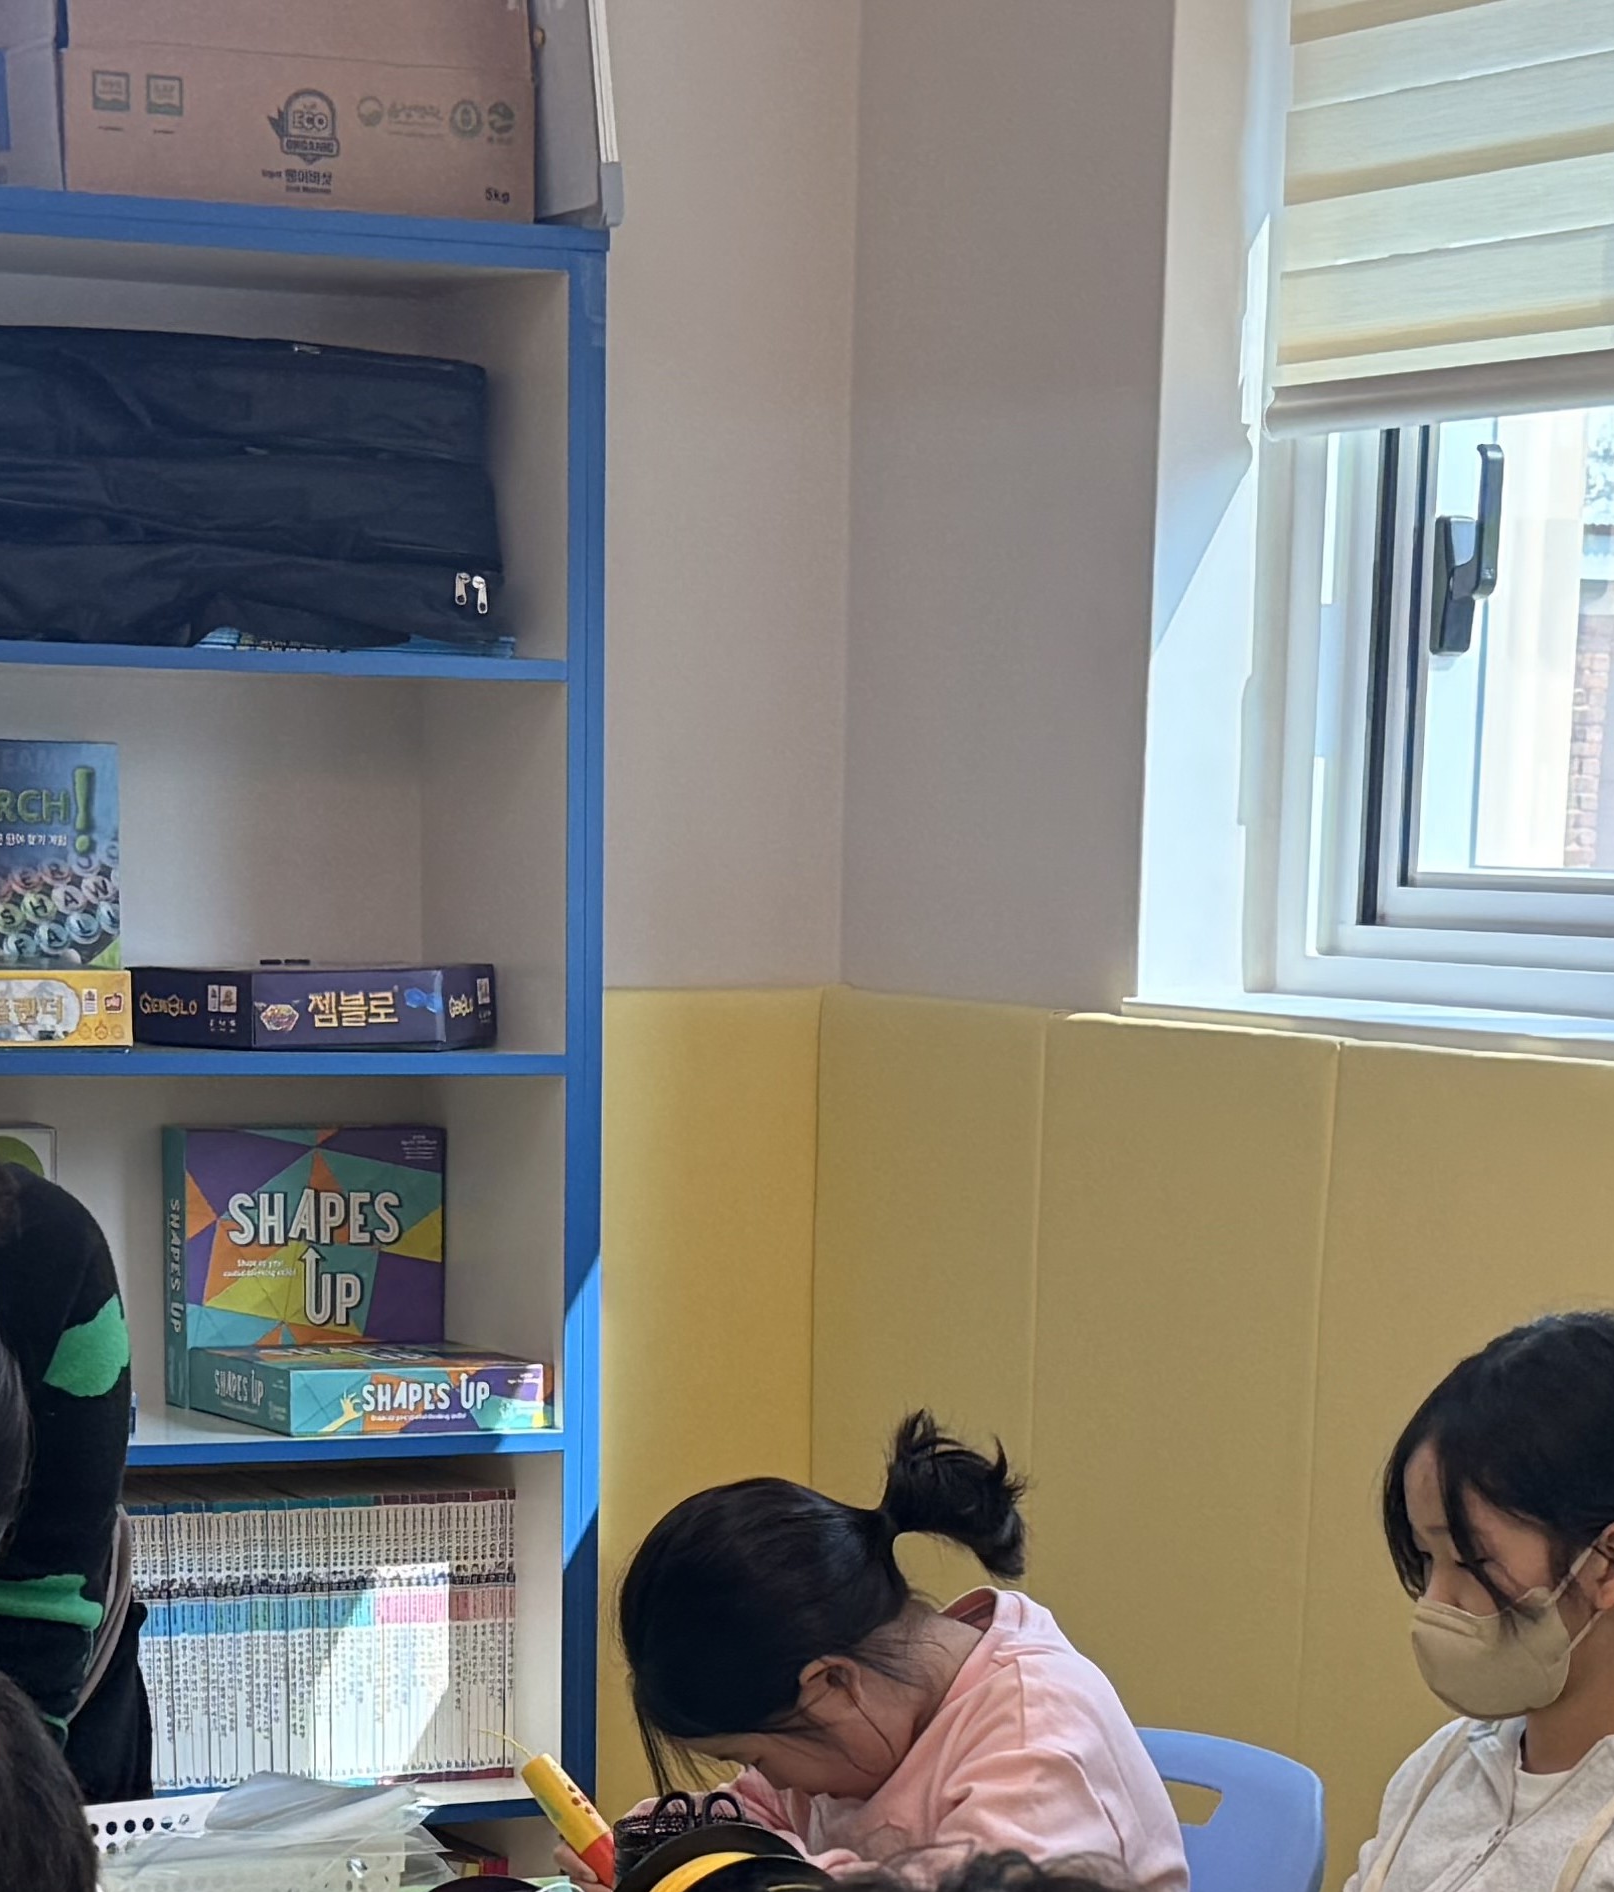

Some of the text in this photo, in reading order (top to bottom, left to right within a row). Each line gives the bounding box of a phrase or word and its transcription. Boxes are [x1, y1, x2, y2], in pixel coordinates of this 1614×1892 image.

[292, 110, 329, 130] ECO
[485, 187, 510, 204] 5kg
[226, 1187, 402, 1246] SHAPES
[169, 1198, 184, 1334] SHAPES UP
[301, 1247, 362, 1327] UP
[214, 1368, 264, 1407] SHAPES UP
[362, 1372, 491, 1412] SHAPES UP
